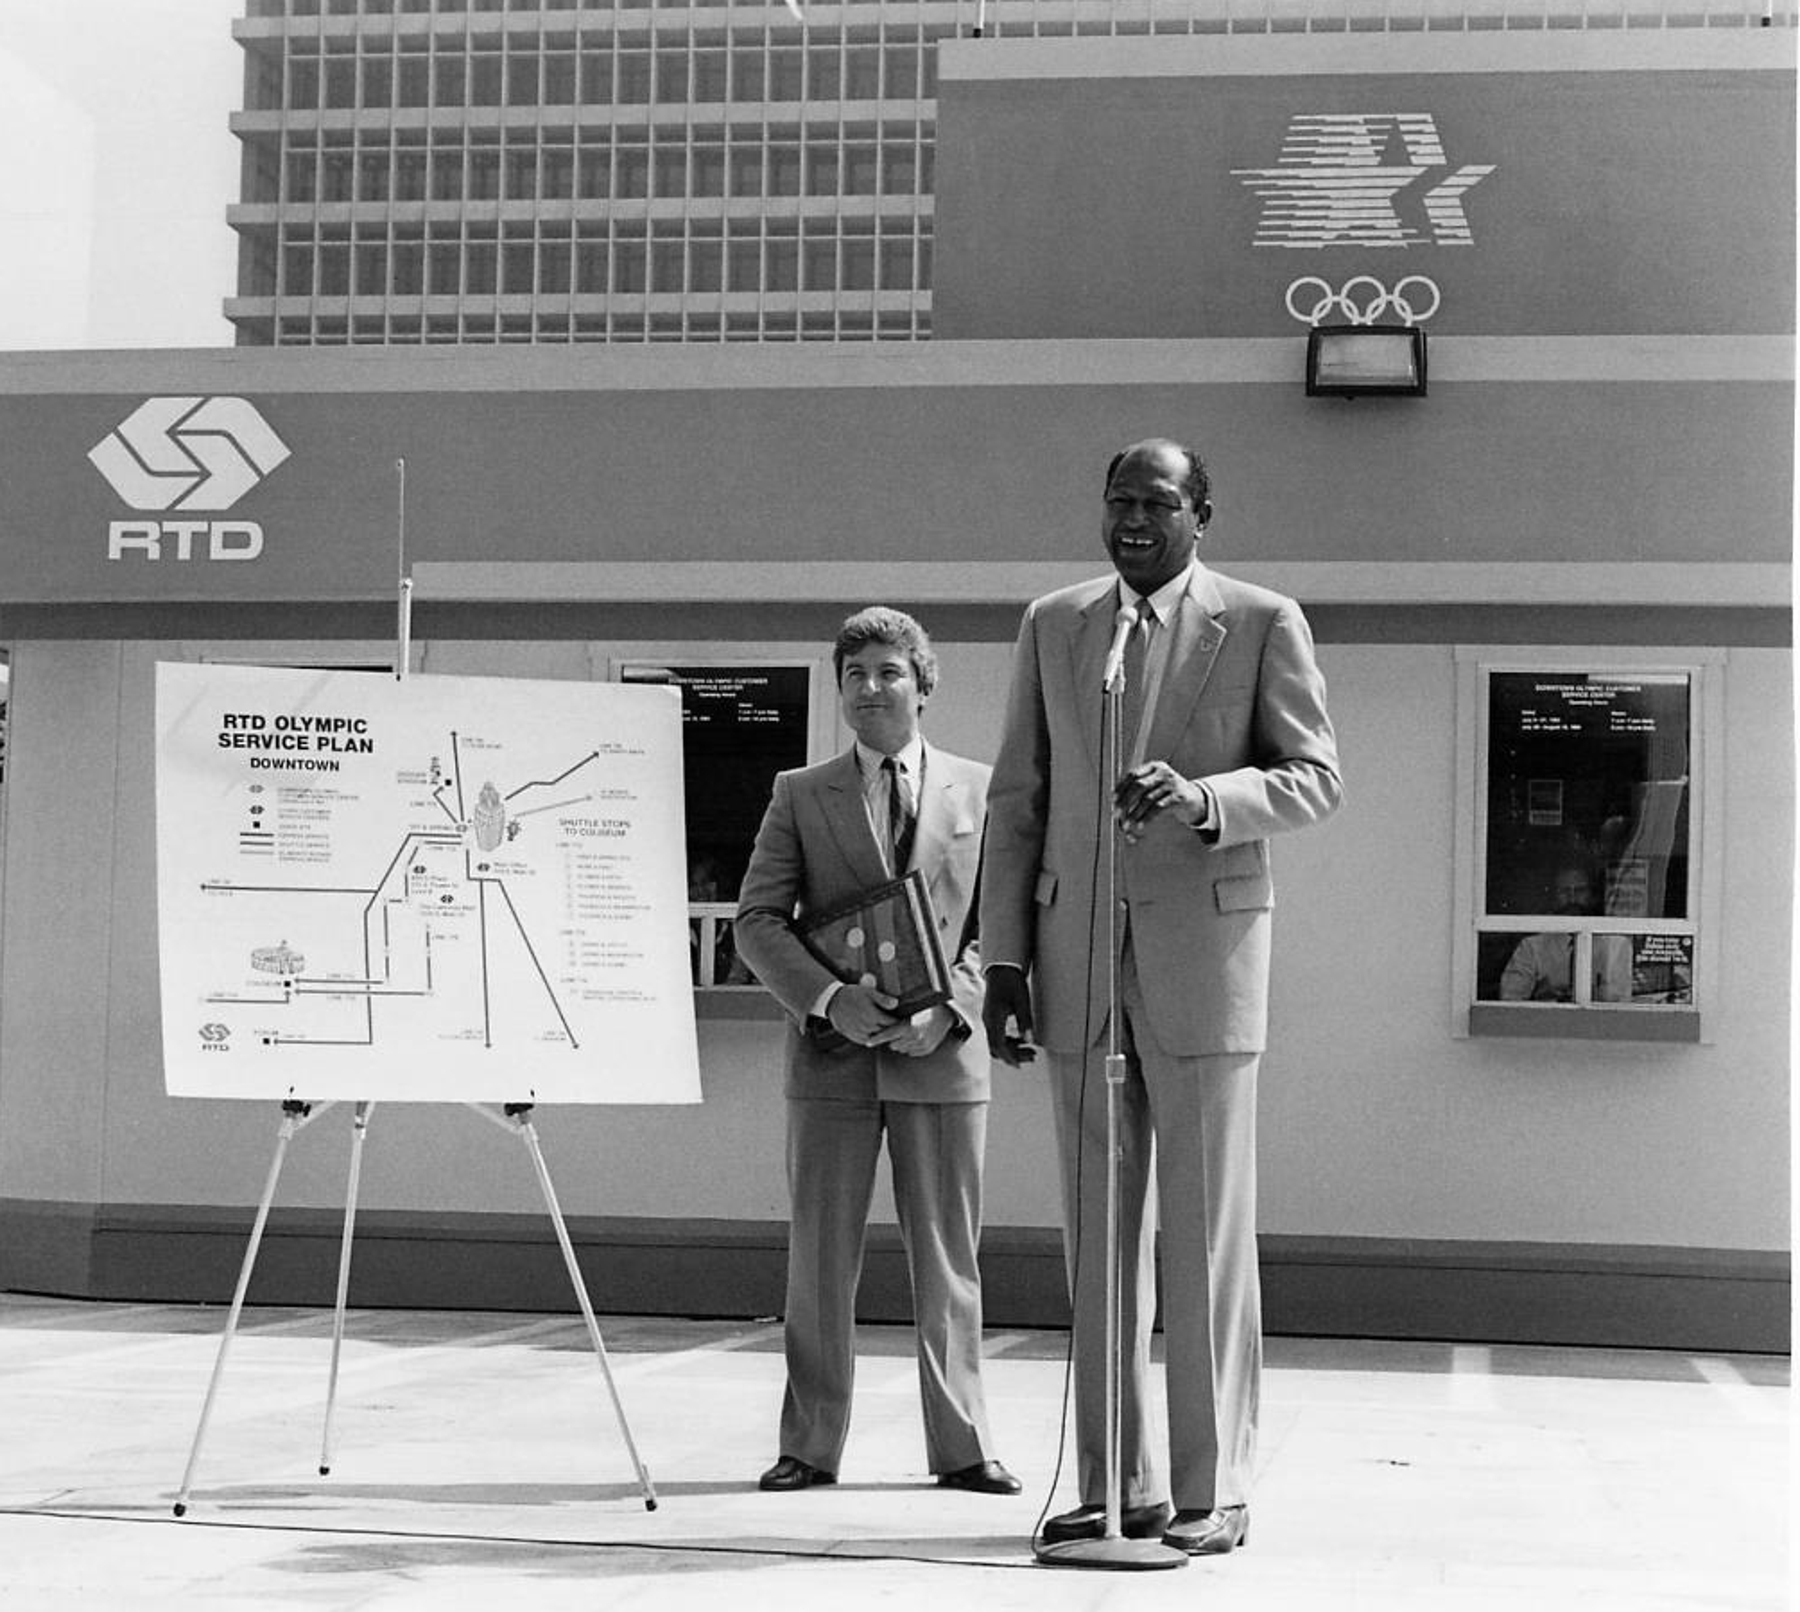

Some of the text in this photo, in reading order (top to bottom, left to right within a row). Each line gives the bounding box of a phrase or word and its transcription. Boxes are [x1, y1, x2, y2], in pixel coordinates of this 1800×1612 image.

[108, 520, 264, 561] RTD
[223, 713, 369, 735] RTD OLYMPIC
[218, 732, 374, 754] SERVICE PLAN
[250, 757, 340, 772] DOWNTOWN
[559, 818, 632, 829] SHUTTLE STOPS
[564, 828, 627, 837] TO COLISEUM
